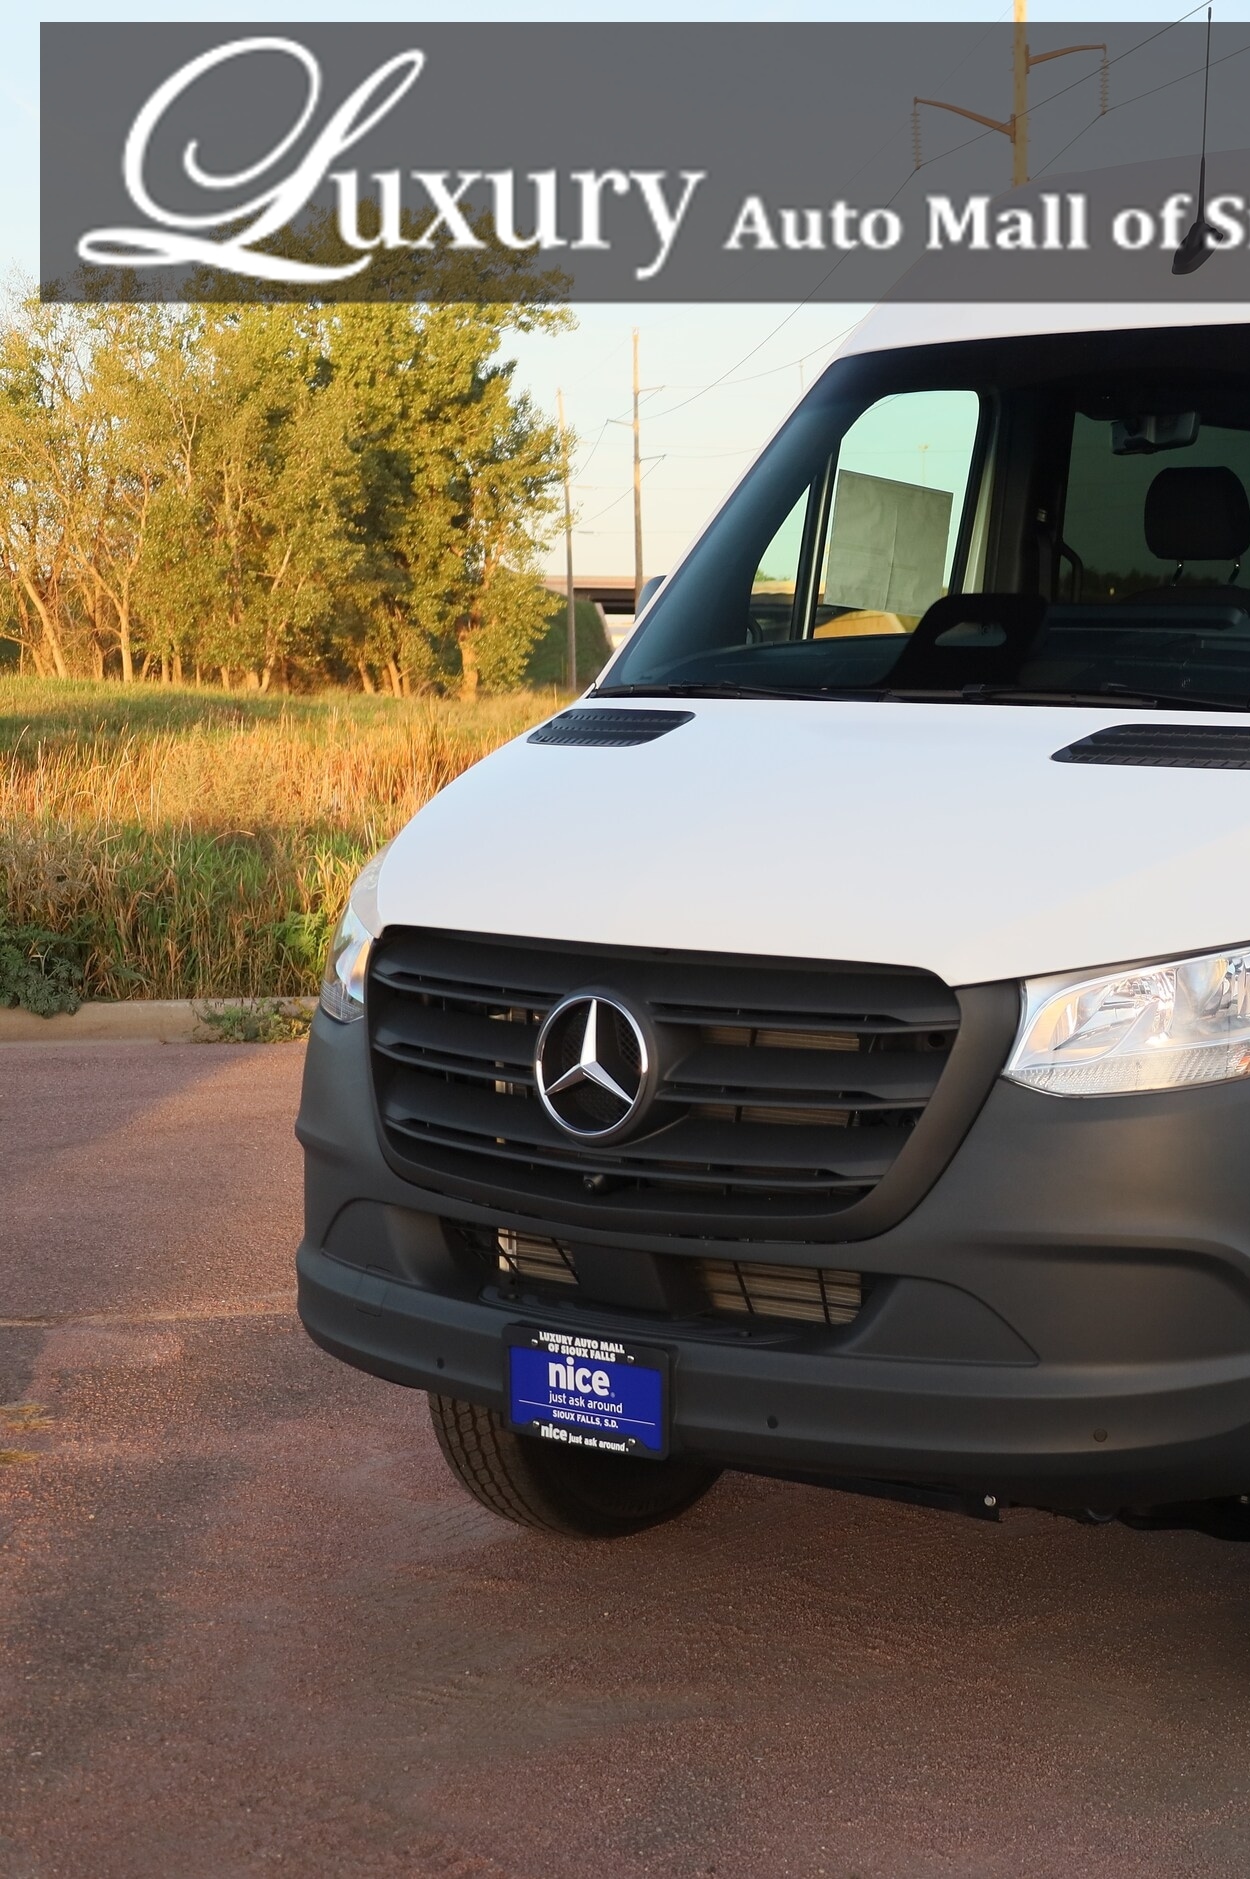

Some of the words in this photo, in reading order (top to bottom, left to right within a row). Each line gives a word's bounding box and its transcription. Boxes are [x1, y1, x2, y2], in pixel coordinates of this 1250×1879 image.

[539, 1331, 572, 1346] LUXURY
[574, 1337, 598, 1349] AUTO
[600, 1342, 625, 1354] MALL
[548, 1343, 560, 1353] OF
[560, 1345, 589, 1358] SIOUX
[590, 1350, 616, 1362] FALLS
[548, 1356, 610, 1396] nice
[548, 1390, 566, 1404] just
[568, 1394, 585, 1407] ask
[588, 1398, 623, 1414] around
[552, 1410, 575, 1421] SIOUX
[576, 1414, 602, 1426] FALLS,
[604, 1418, 618, 1428] S.D.
[541, 1424, 567, 1440] nice
[568, 1433, 582, 1444] just
[584, 1436, 598, 1446] ask
